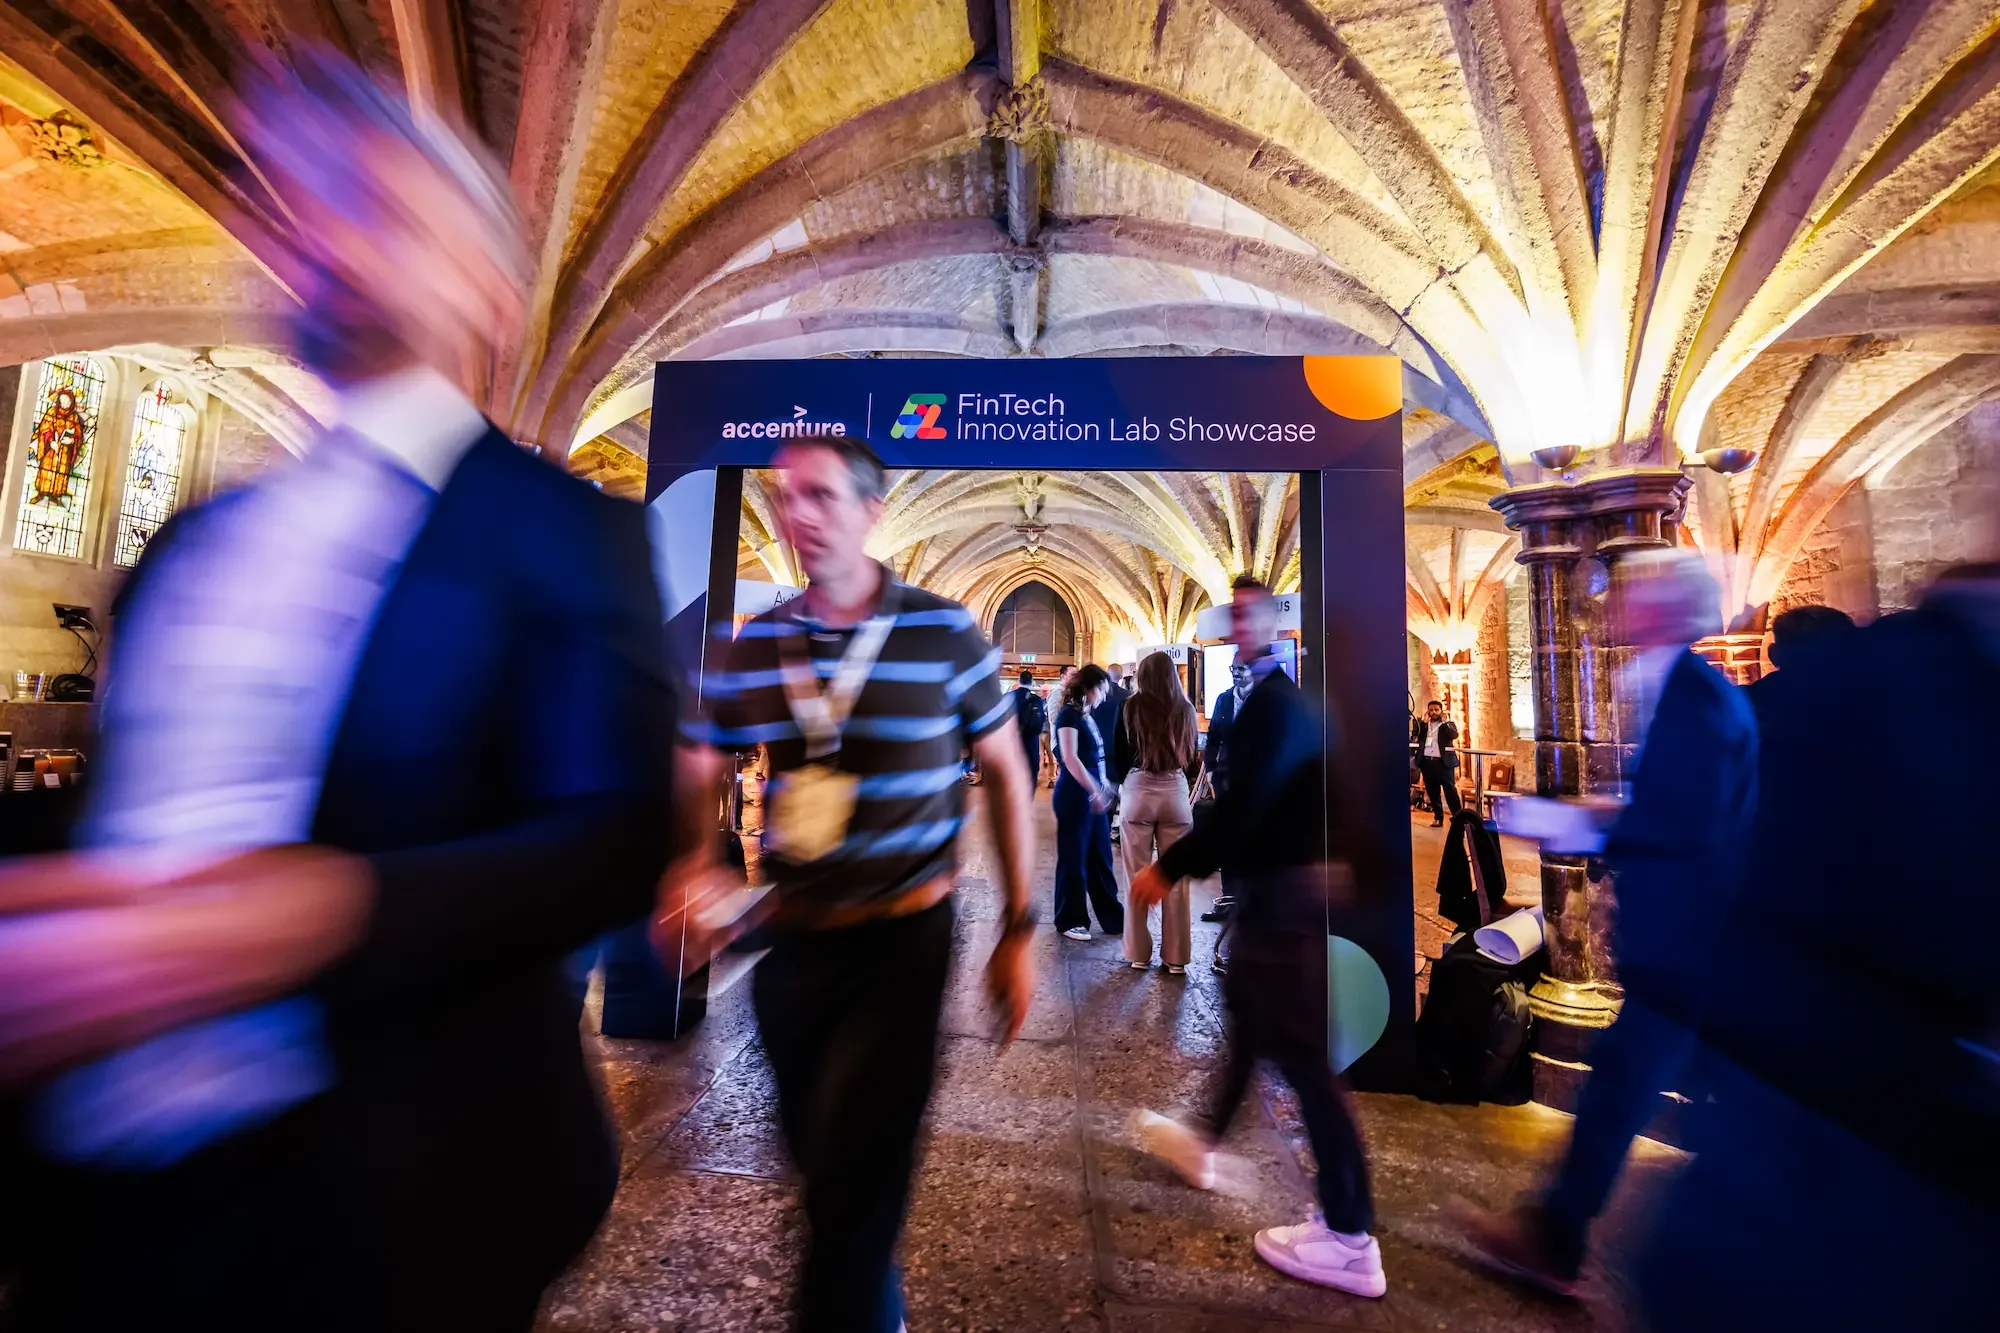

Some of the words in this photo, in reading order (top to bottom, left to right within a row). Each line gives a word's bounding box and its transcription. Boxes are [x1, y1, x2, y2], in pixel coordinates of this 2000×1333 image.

[958, 393, 1065, 416] FinTech
[721, 416, 846, 439] accenture
[957, 417, 1100, 441] Innovation
[1110, 416, 1161, 441] Lab
[1168, 416, 1316, 442] Showcase
